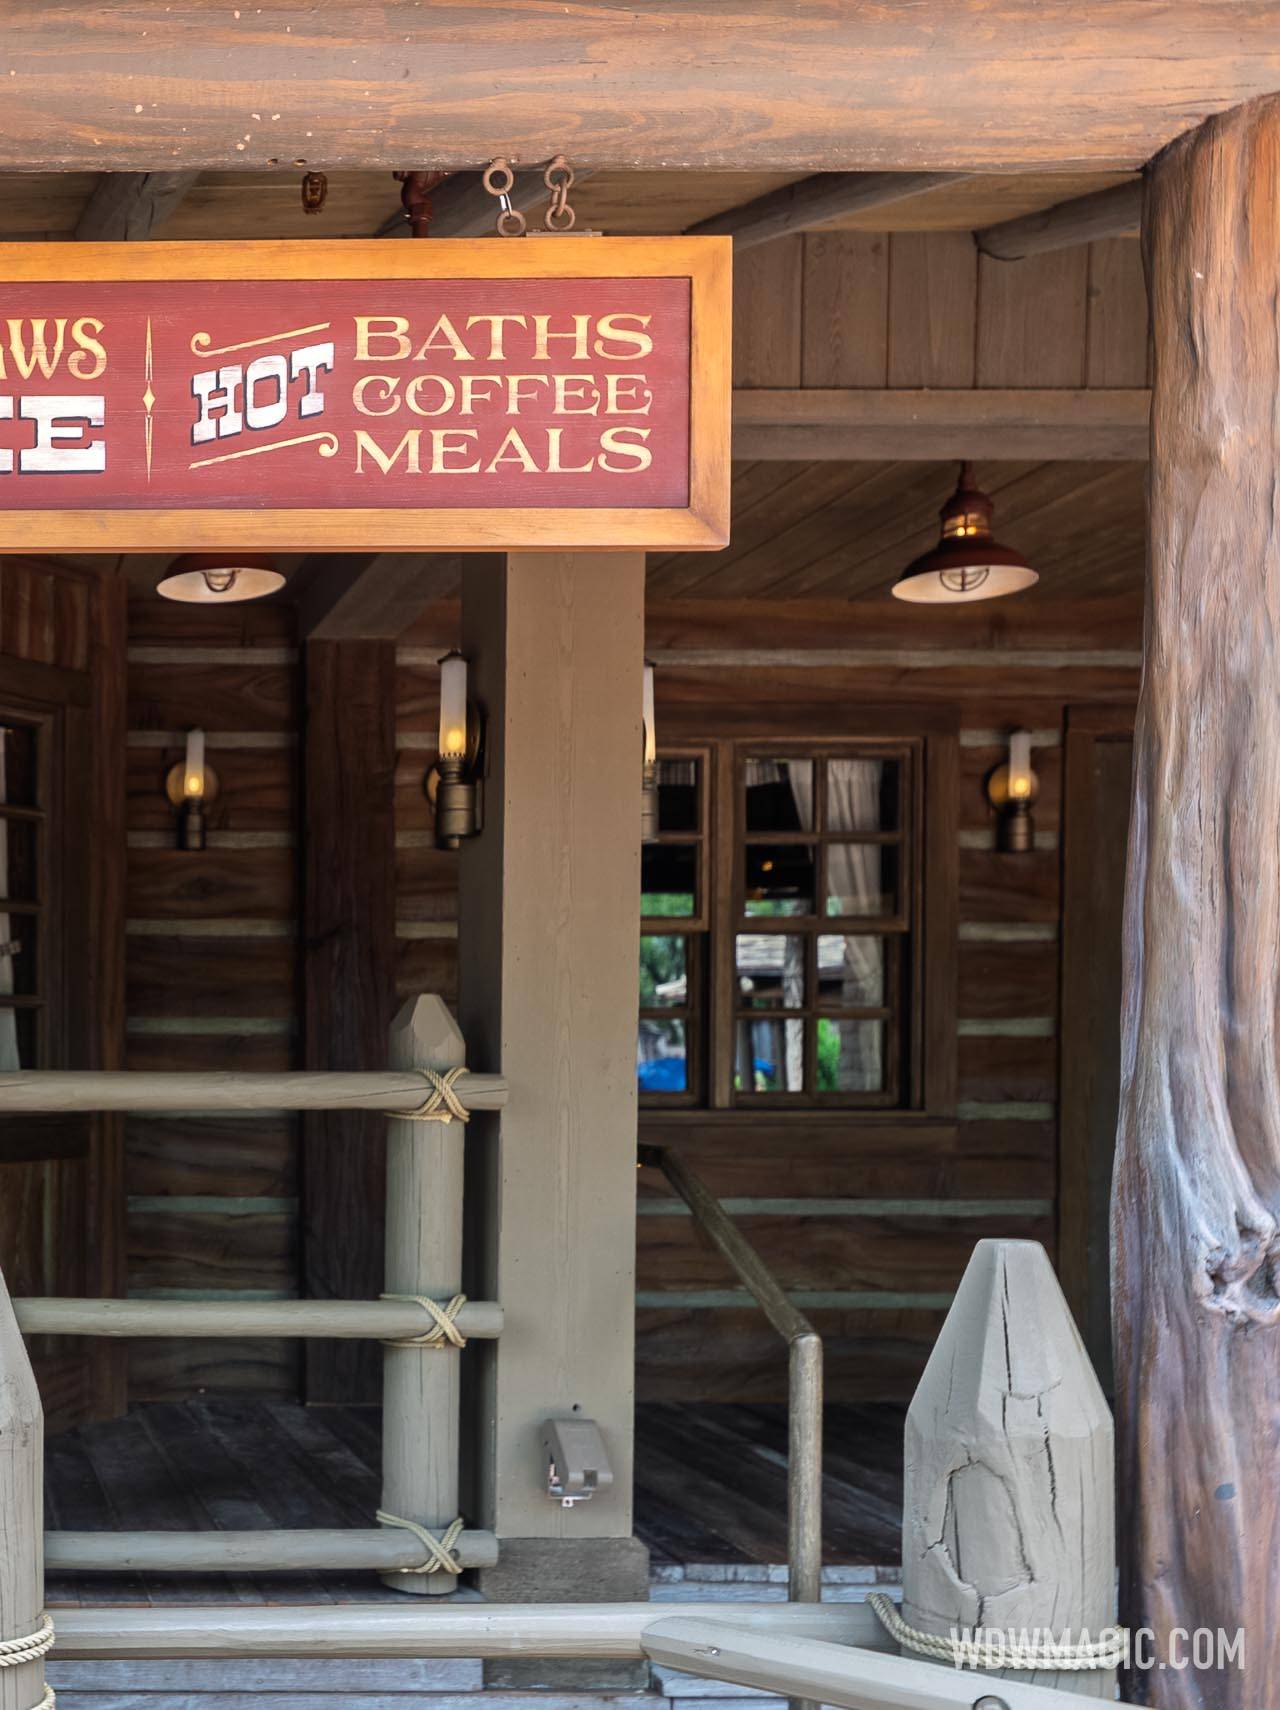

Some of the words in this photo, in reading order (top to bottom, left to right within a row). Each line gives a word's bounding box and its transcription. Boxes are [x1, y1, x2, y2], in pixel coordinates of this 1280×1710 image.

[353, 313, 654, 361] BATHS
[191, 342, 335, 445] HOT
[352, 374, 654, 416] COFFEE
[354, 427, 654, 475] MEALS
